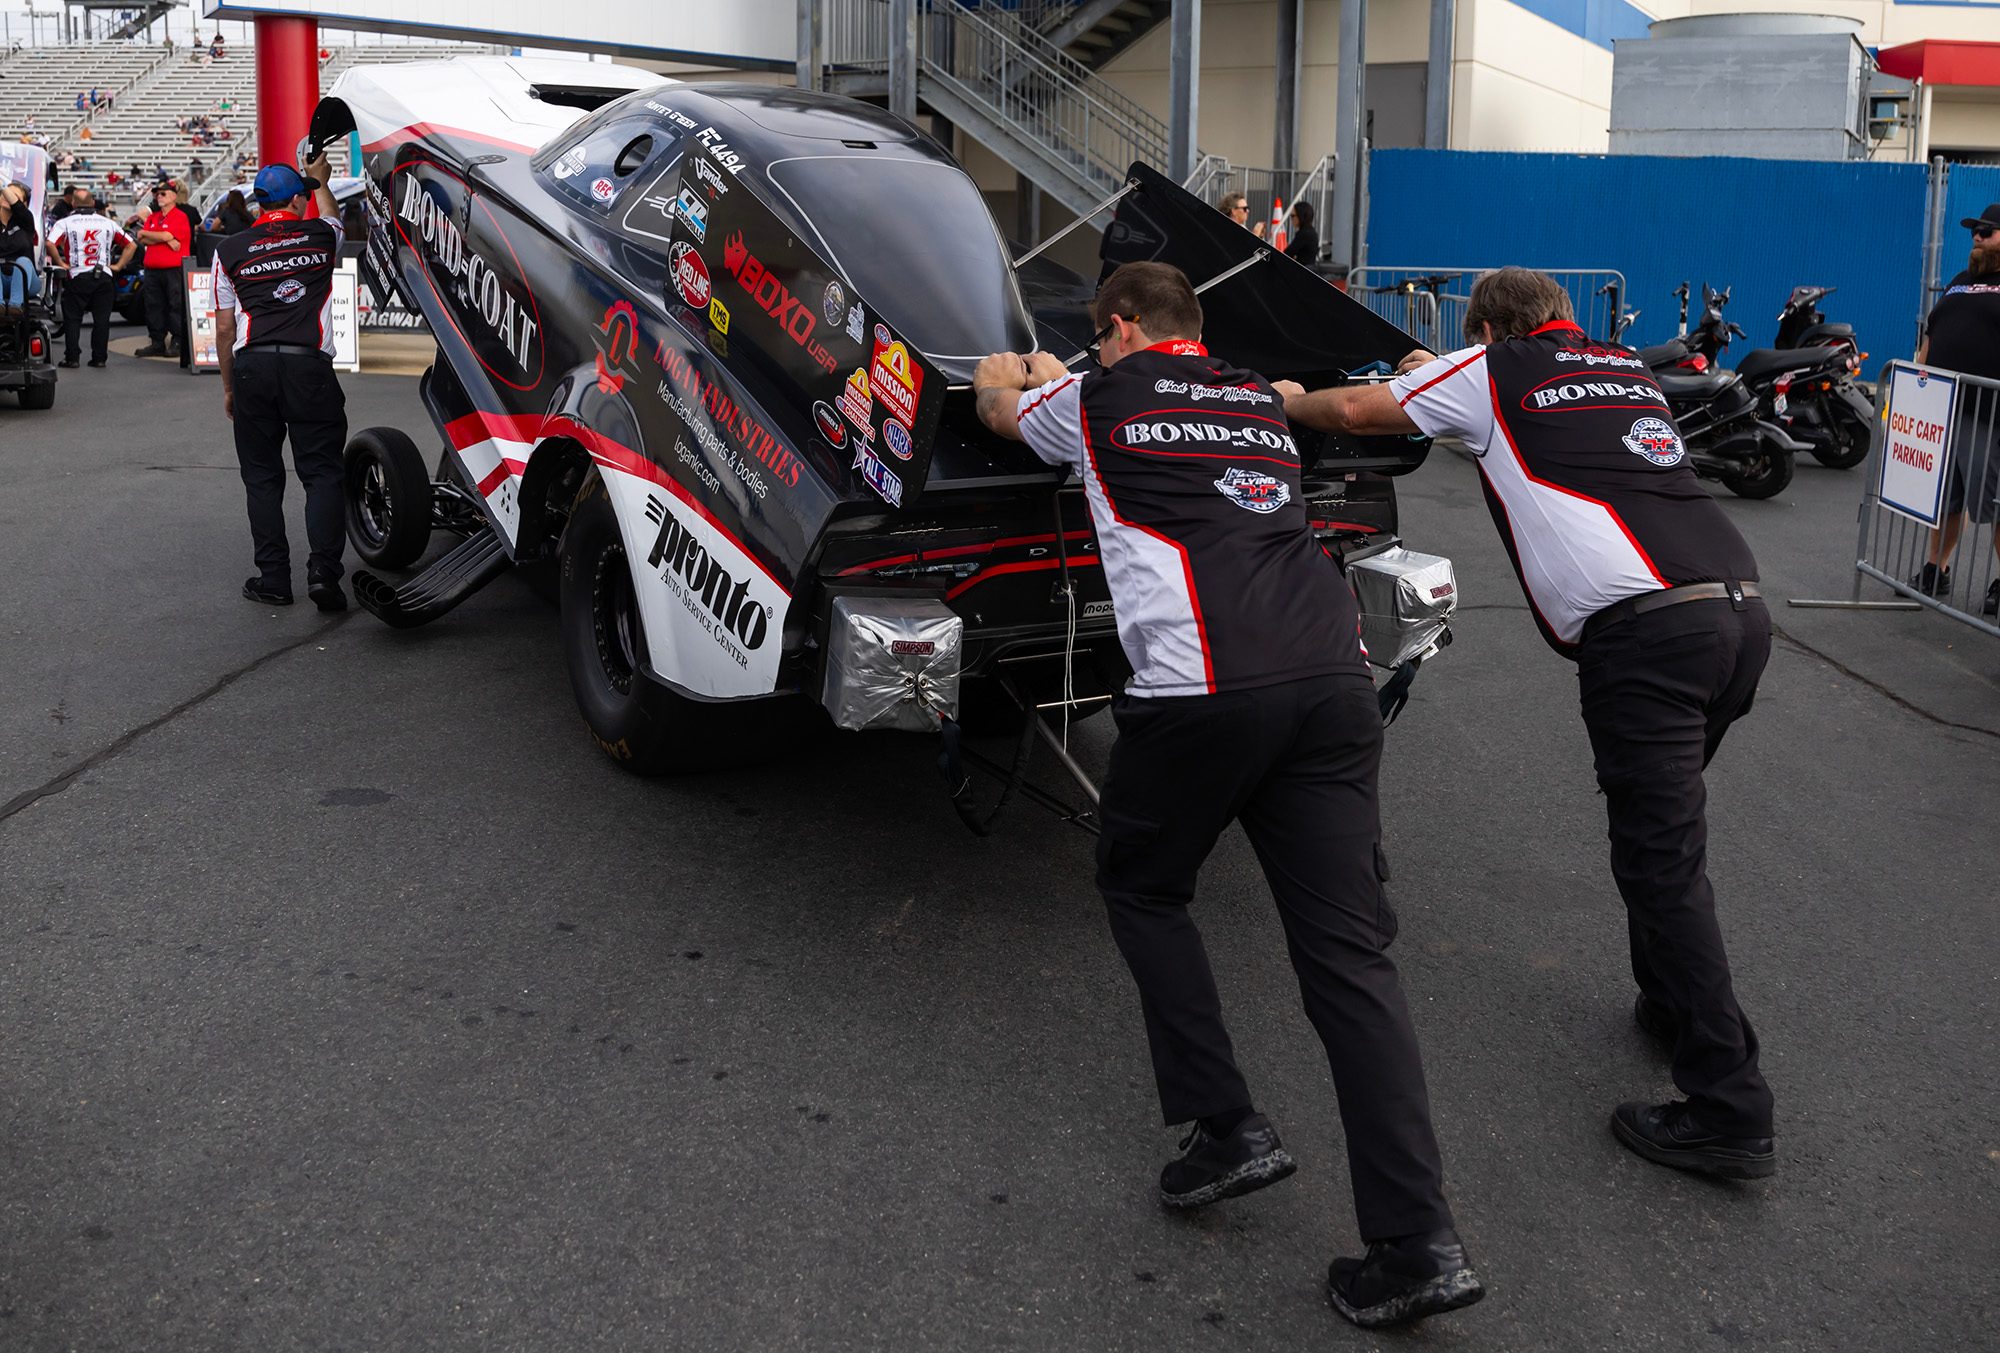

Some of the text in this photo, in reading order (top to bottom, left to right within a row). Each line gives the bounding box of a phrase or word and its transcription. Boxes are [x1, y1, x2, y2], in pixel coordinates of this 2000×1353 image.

[594, 180, 613, 197] RFC
[677, 207, 705, 242] CARRILLO
[399, 172, 537, 373] BOND-COAT
[680, 258, 709, 298] RED LINE
[358, 311, 423, 328] RAGWAY
[712, 302, 727, 322] TMS
[738, 255, 838, 375] BOXO USA
[875, 364, 912, 411] MISSION
[1155, 379, 1188, 394] Chad
[1190, 384, 1222, 401] Green
[653, 338, 704, 397] LOGAN
[701, 383, 804, 488] INDUSTRIES
[1891, 411, 1944, 445] GOLF CART
[657, 380, 768, 499] Manufacturing parts & bodies
[887, 424, 909, 454] NHRA
[1124, 422, 1299, 456] BOND-COA
[674, 435, 720, 494] logankc.com
[1892, 441, 1933, 473] PARKING
[865, 456, 901, 503] ALL STAR
[1232, 477, 1276, 486] FLYING
[661, 568, 748, 671] AUTO SERVICE CENTER
[894, 642, 932, 654] SIMPSON
